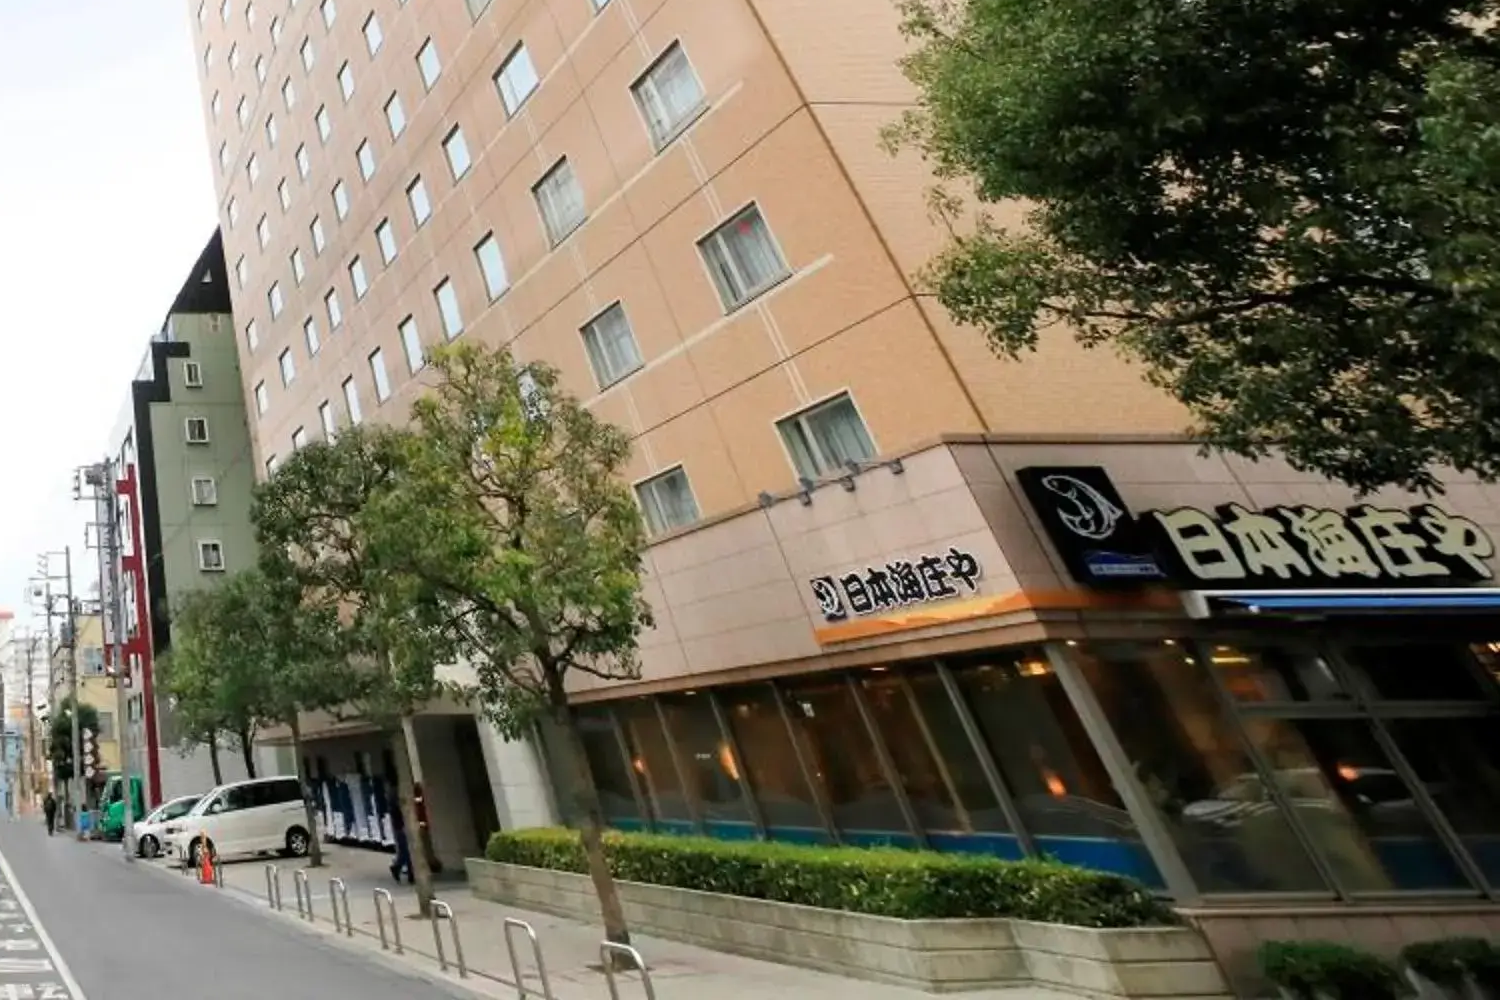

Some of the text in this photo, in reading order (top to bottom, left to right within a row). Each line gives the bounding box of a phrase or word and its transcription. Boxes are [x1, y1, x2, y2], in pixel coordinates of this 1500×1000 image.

[1153, 502, 1494, 579] 日本海庄や
[839, 547, 980, 613] 日本海庄や
